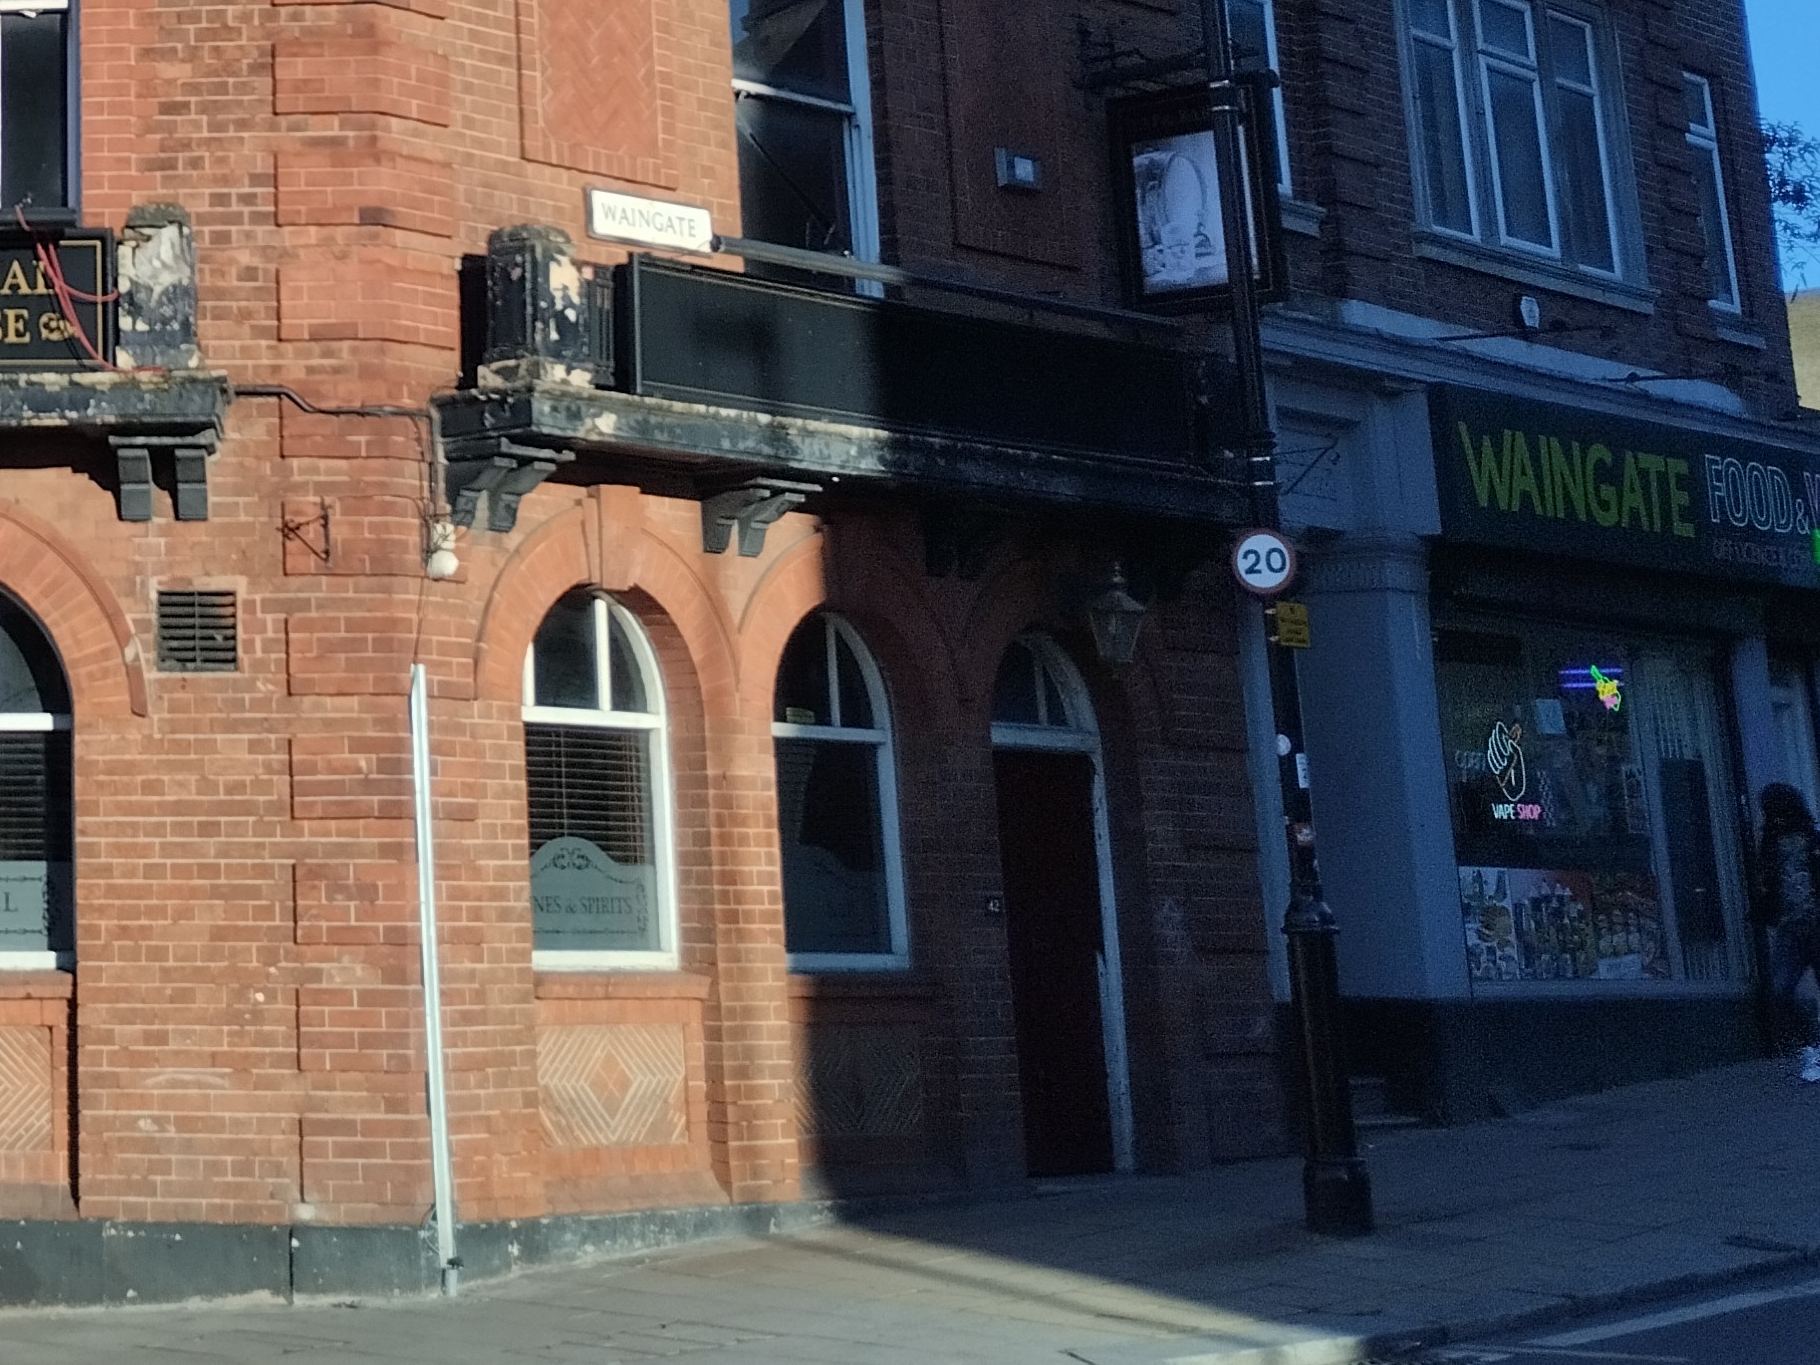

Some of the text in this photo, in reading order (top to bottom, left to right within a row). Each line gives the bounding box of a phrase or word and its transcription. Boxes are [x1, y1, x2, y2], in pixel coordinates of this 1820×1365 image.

[601, 202, 697, 238] WAINGATE
[1457, 420, 1695, 537] WAINGATE
[1705, 454, 1793, 533] FOOD
[1241, 546, 1287, 575] 20
[1491, 803, 1542, 820] VAPE SHOP
[532, 895, 562, 914] NES
[580, 896, 633, 915] SPIRITS
